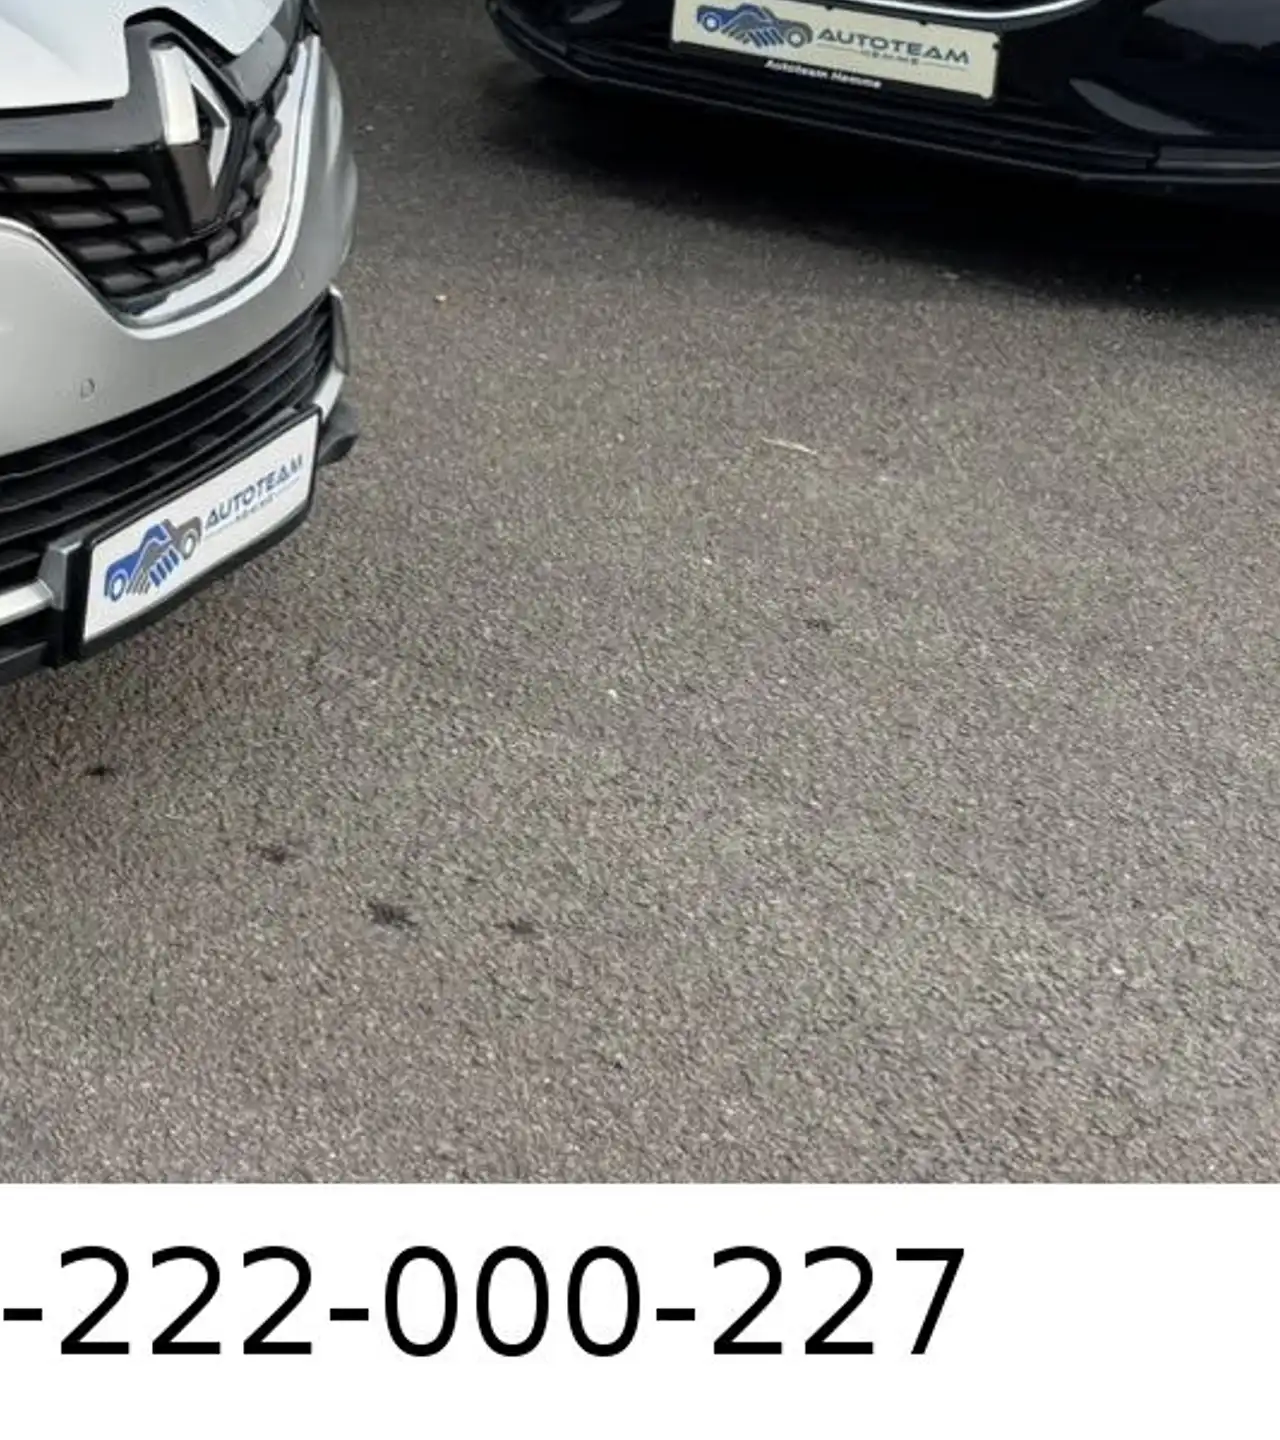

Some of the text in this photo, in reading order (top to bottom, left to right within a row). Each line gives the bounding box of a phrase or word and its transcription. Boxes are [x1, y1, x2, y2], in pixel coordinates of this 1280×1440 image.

[817, 27, 970, 65] AUTOTEAM
[764, 59, 828, 79] Autoteam
[205, 453, 302, 530] AUTOTEAM
